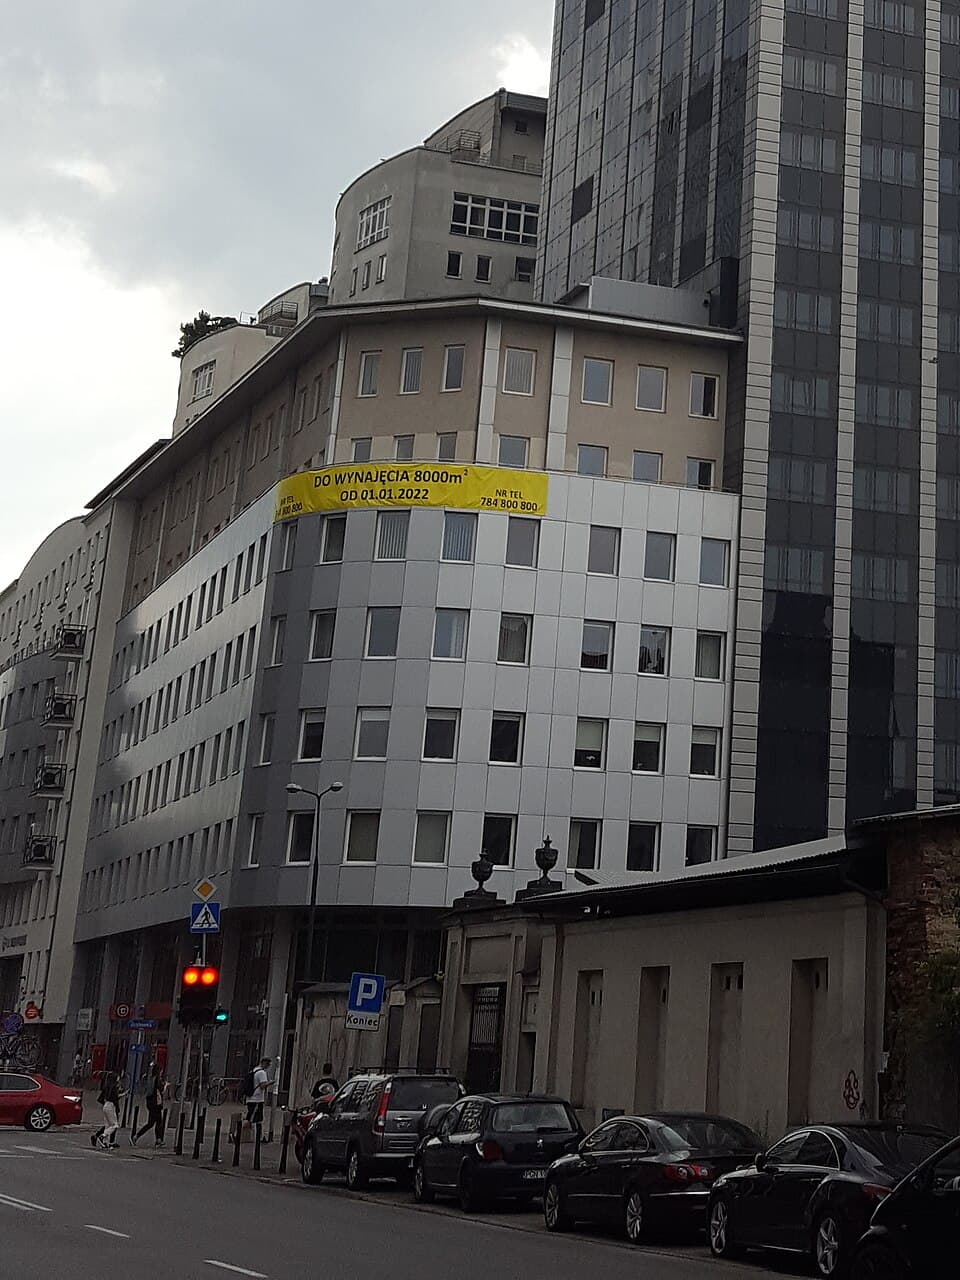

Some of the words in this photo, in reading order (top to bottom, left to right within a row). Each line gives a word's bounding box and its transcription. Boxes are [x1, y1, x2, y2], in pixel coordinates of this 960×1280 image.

[314, 474, 331, 488] DO
[335, 470, 410, 485] WYNAJĘCIA
[340, 490, 358, 502] OD
[360, 488, 429, 501] 01.01.2022
[495, 489, 507, 498] NR
[509, 490, 523, 499] TEL
[480, 497, 498, 507] 784
[500, 499, 518, 509] 800
[520, 501, 538, 511] 800
[356, 977, 378, 1007] P
[346, 1014, 378, 1026] Koniec
